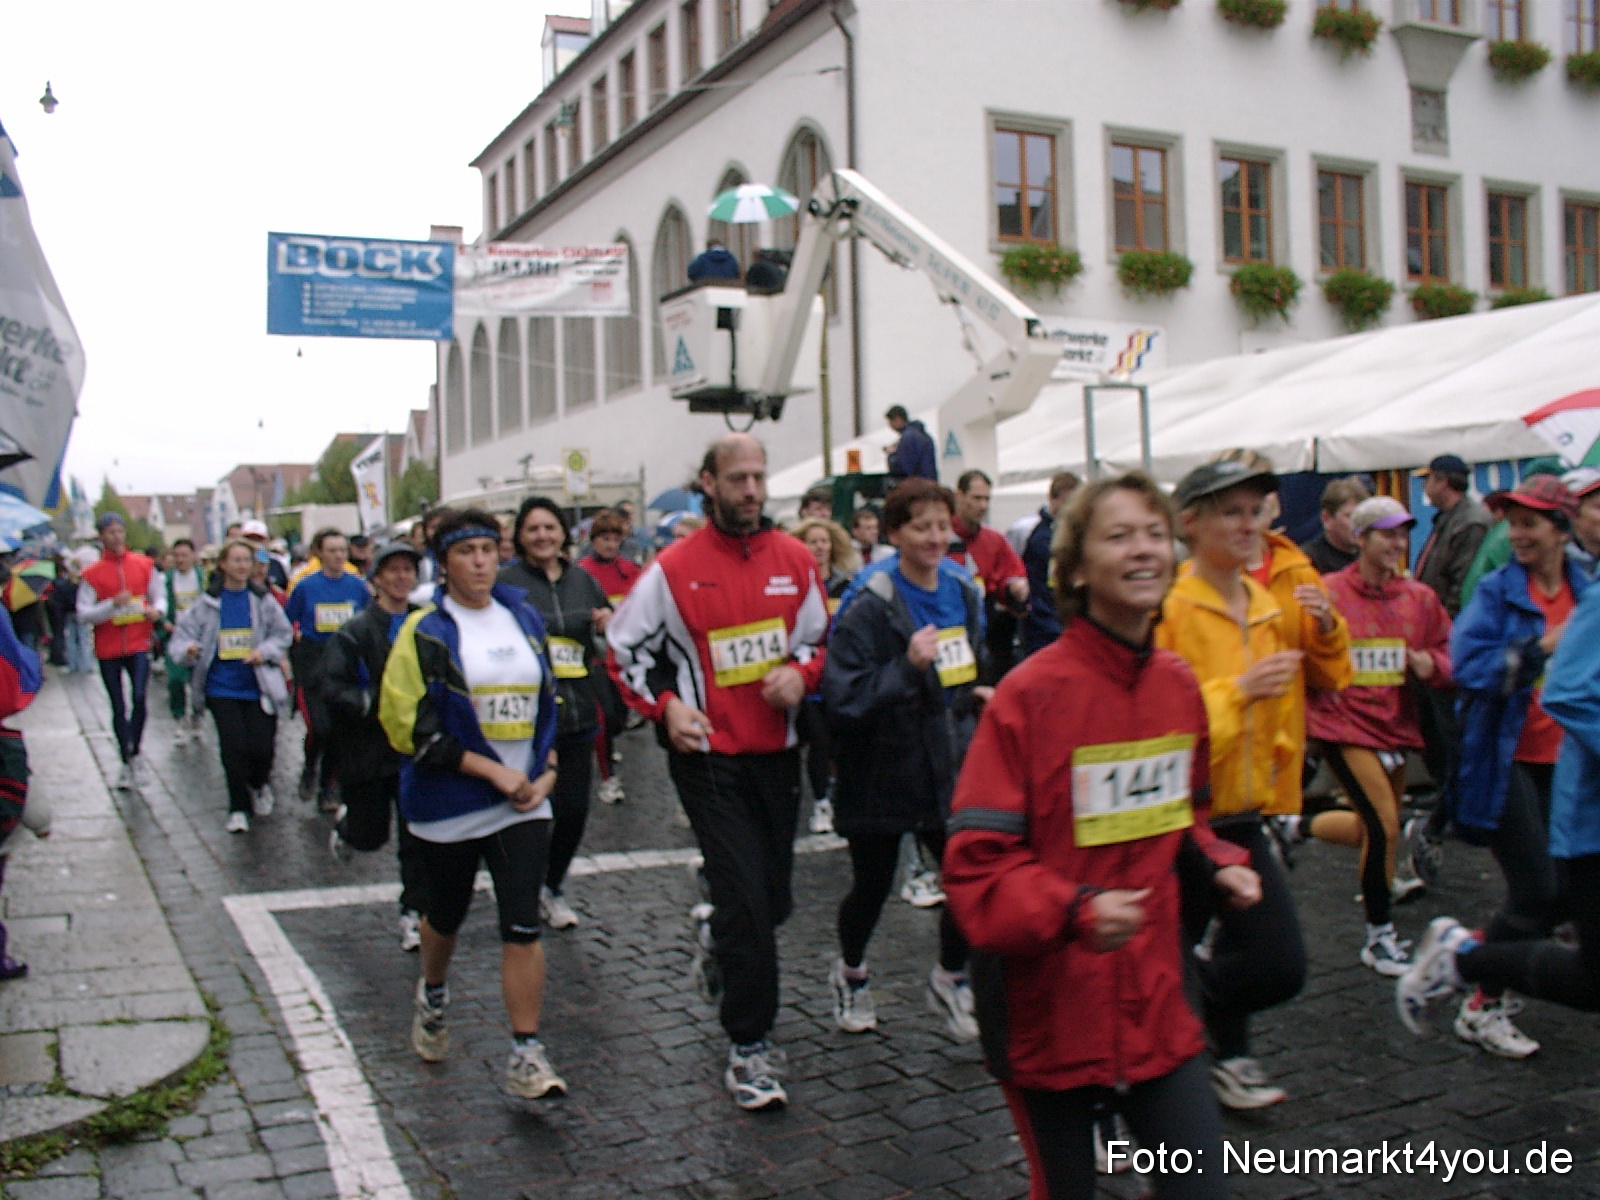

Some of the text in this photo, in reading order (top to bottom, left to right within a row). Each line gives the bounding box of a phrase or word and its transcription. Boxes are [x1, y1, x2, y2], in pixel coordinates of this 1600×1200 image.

[277, 237, 443, 281] BOCK
[728, 632, 782, 664] 1214
[1356, 651, 1399, 669] 1141
[487, 695, 531, 720] 1437
[1102, 757, 1179, 808] 1441
